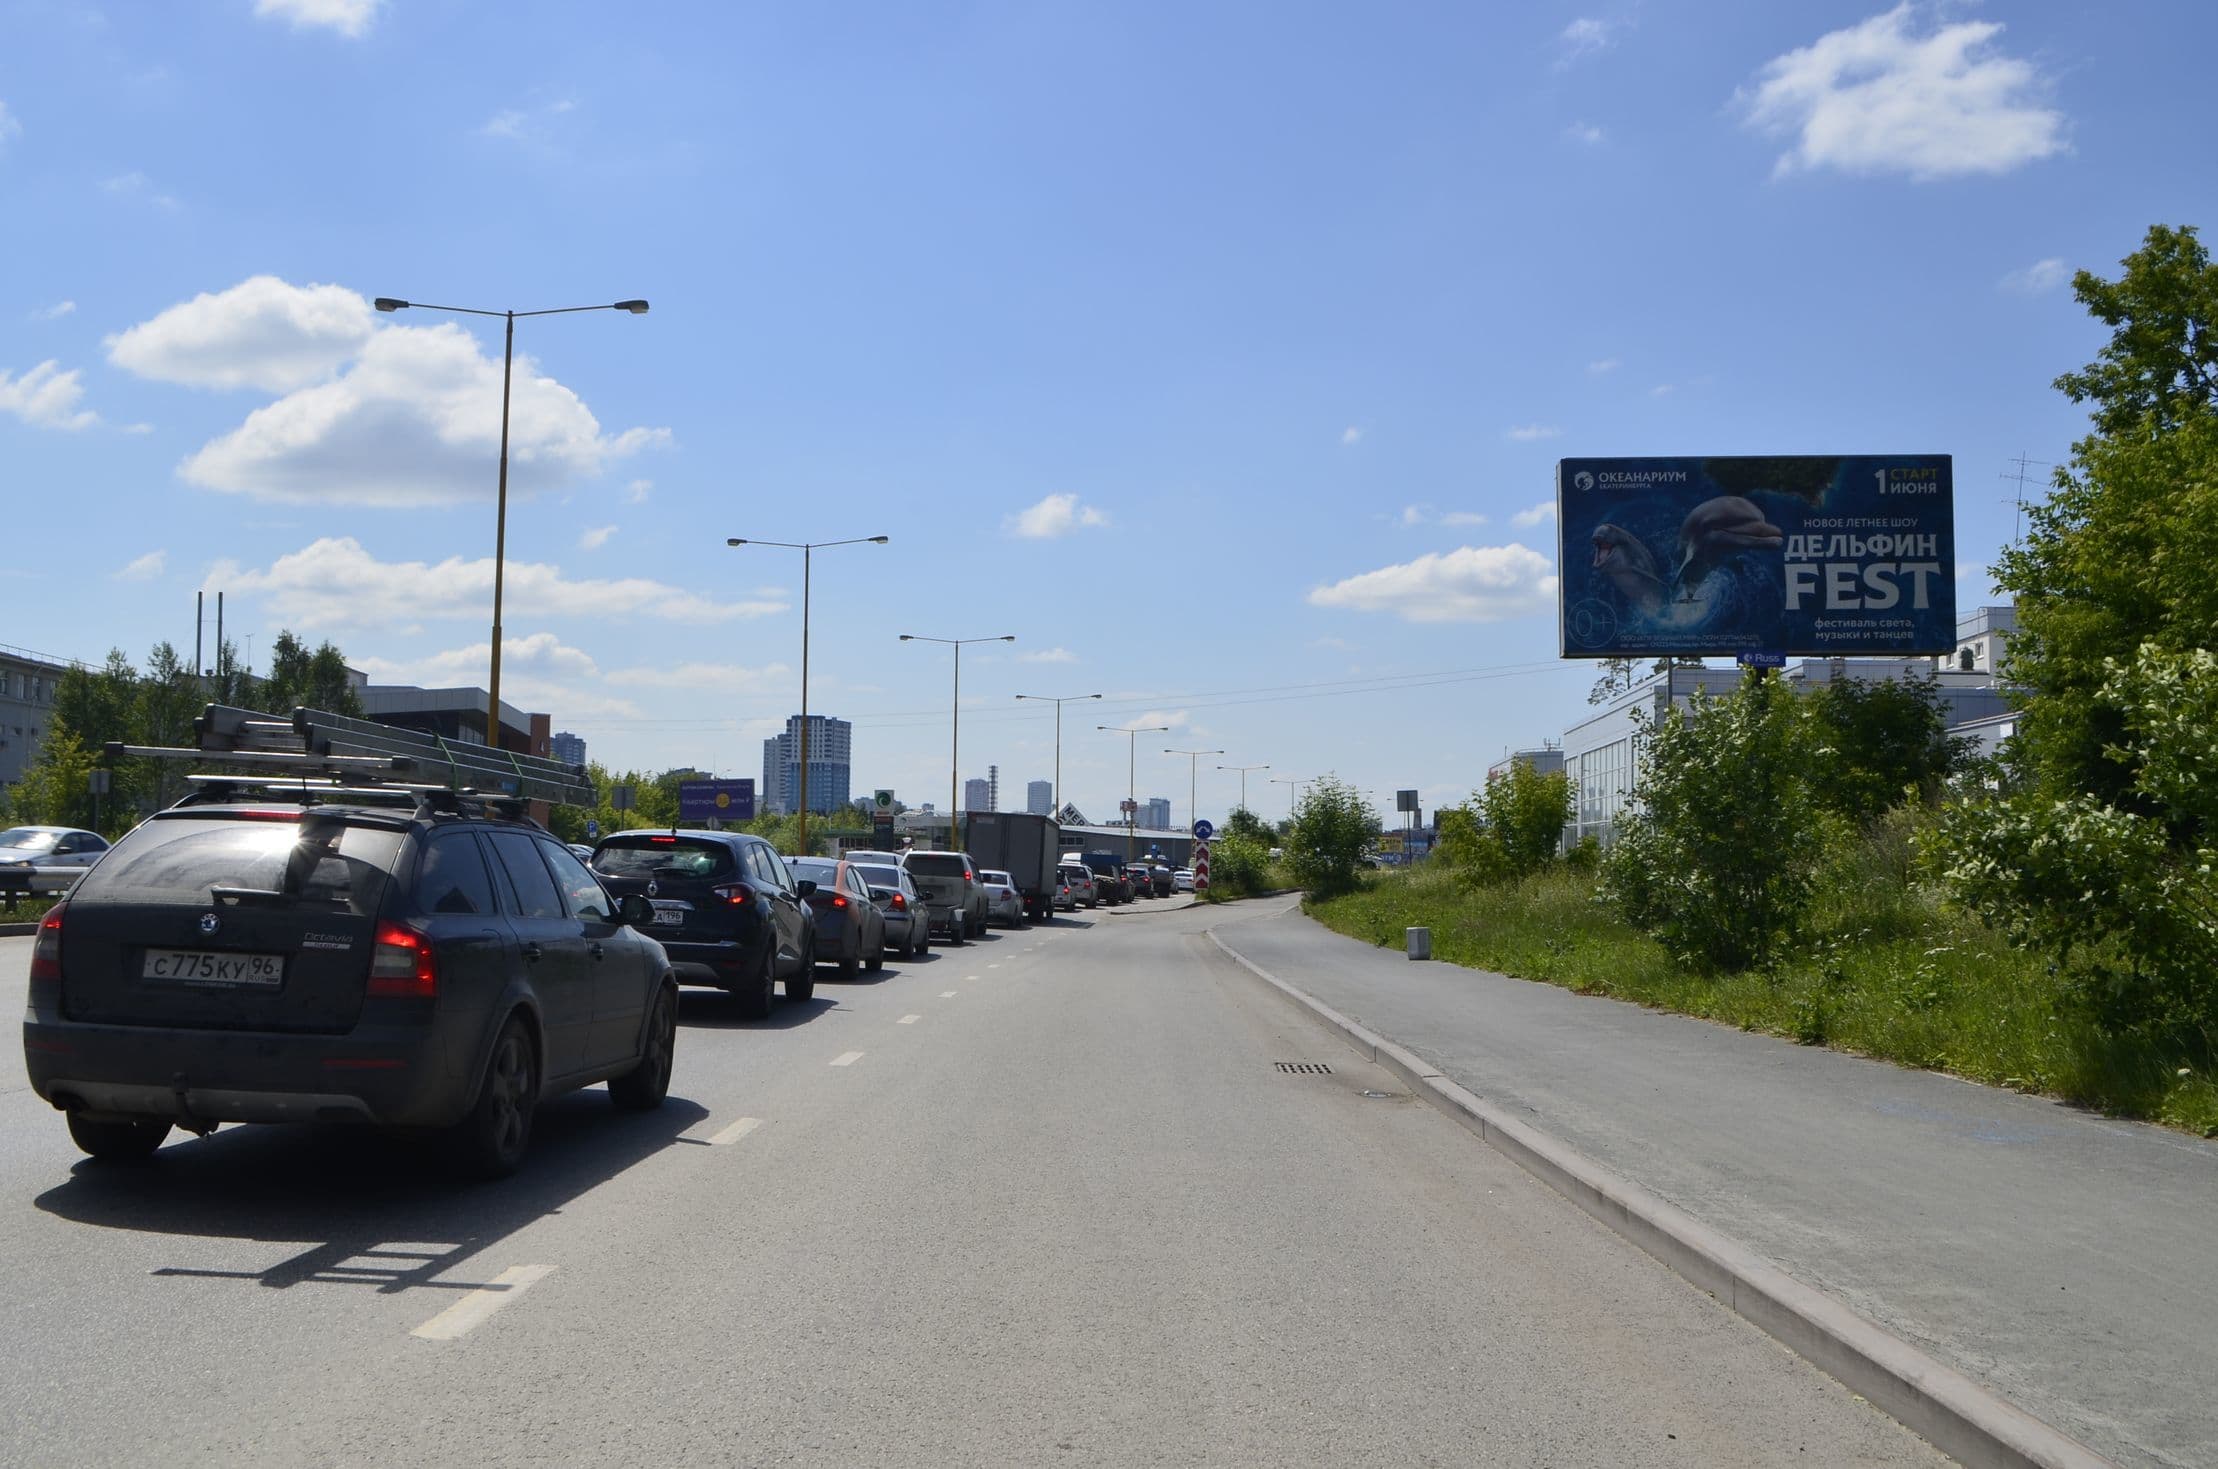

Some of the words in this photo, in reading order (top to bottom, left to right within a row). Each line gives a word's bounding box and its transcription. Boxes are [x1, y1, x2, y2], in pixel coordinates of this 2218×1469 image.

[1598, 471, 1687, 483] ОКЕАНАРИУМ
[1874, 468, 1886, 494] 1
[1890, 482, 1937, 494] ИЮНЯ
[1890, 468, 1938, 481] СТАРТ
[1803, 518, 1844, 528] НОВОЕ
[1846, 517, 1889, 528] ЛЕТНЕЕ
[1890, 517, 1919, 527] ШОУ
[1784, 533, 1938, 561] ДЕЛЬФИН
[1784, 562, 1941, 610] FEST
[1575, 609, 1613, 637] 0+
[1814, 616, 1878, 631] фестиваль
[1878, 618, 1915, 629] света,
[1815, 631, 1861, 642] музыки
[1863, 631, 1871, 640] и
[1873, 631, 1914, 641] танцев
[1755, 653, 1780, 663] Russ
[154, 954, 246, 979] С775КУ
[252, 958, 274, 975] 96
